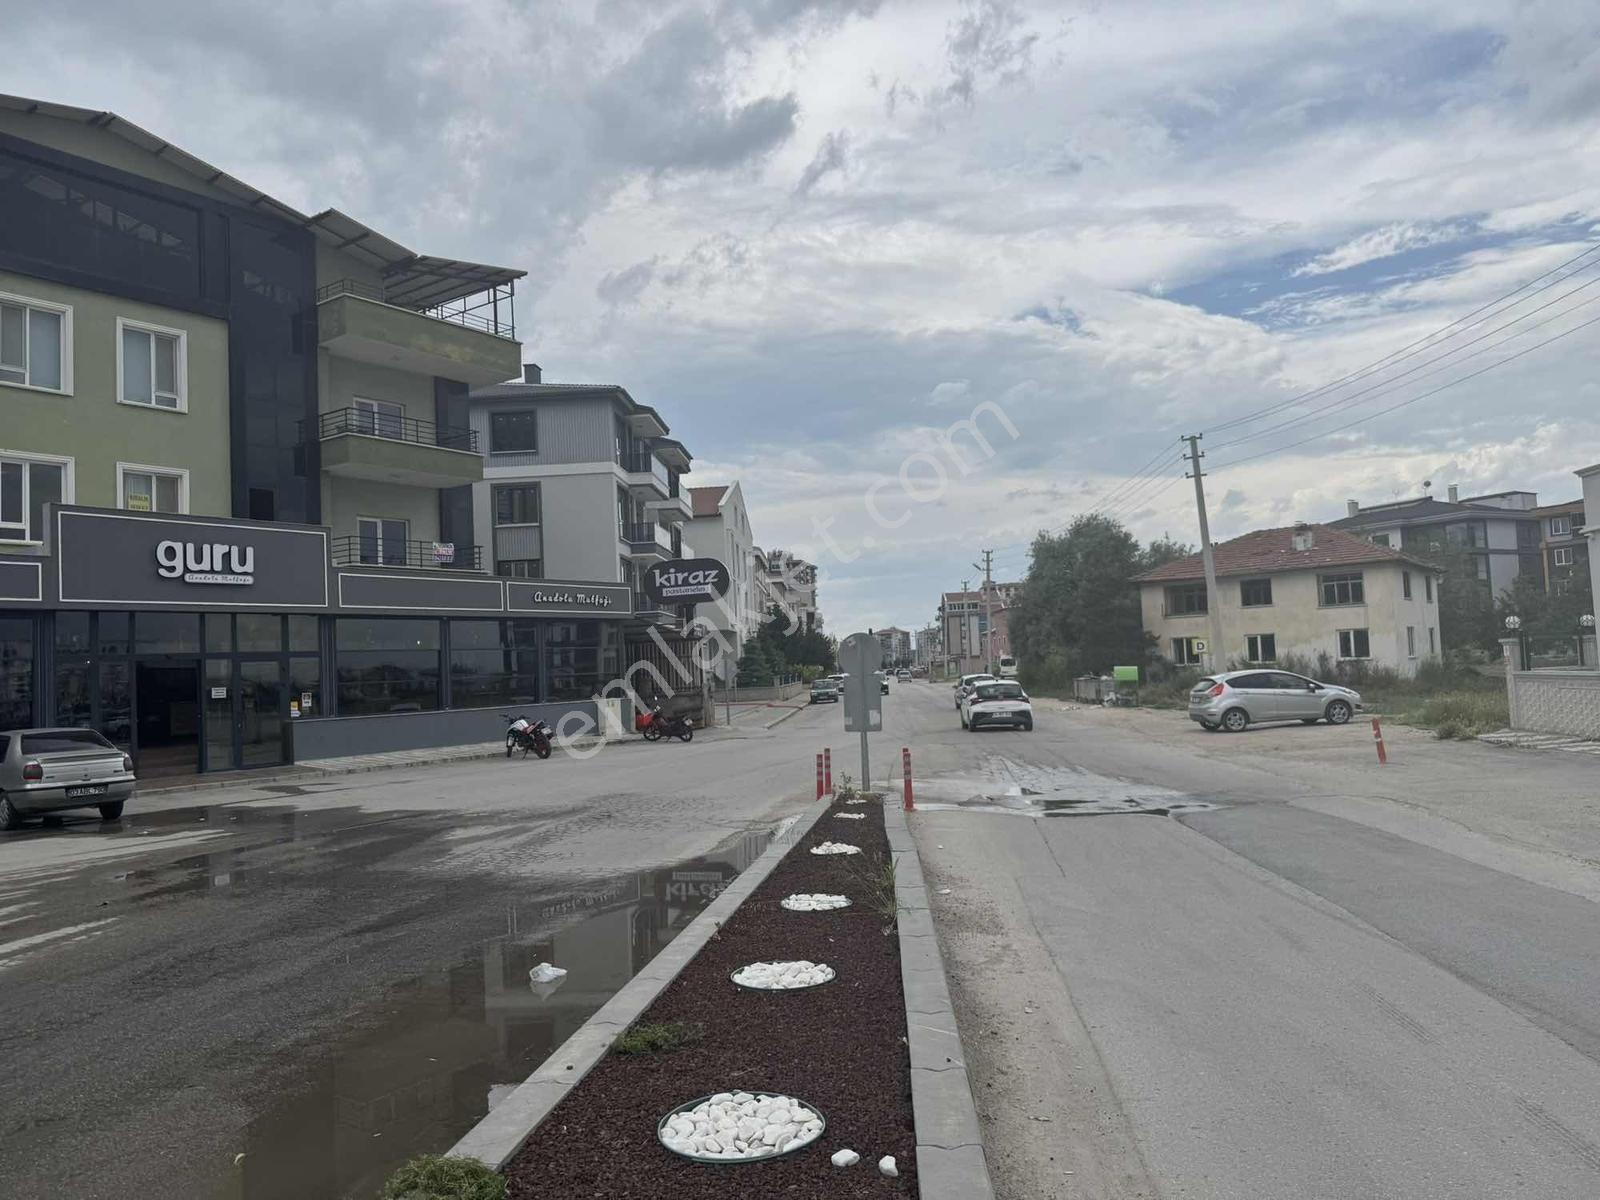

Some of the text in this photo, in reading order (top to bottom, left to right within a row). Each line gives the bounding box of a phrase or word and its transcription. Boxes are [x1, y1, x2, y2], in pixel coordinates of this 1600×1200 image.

[156, 540, 254, 577] guru
[653, 567, 719, 587] kiraz
[534, 591, 573, 603] Anadolu
